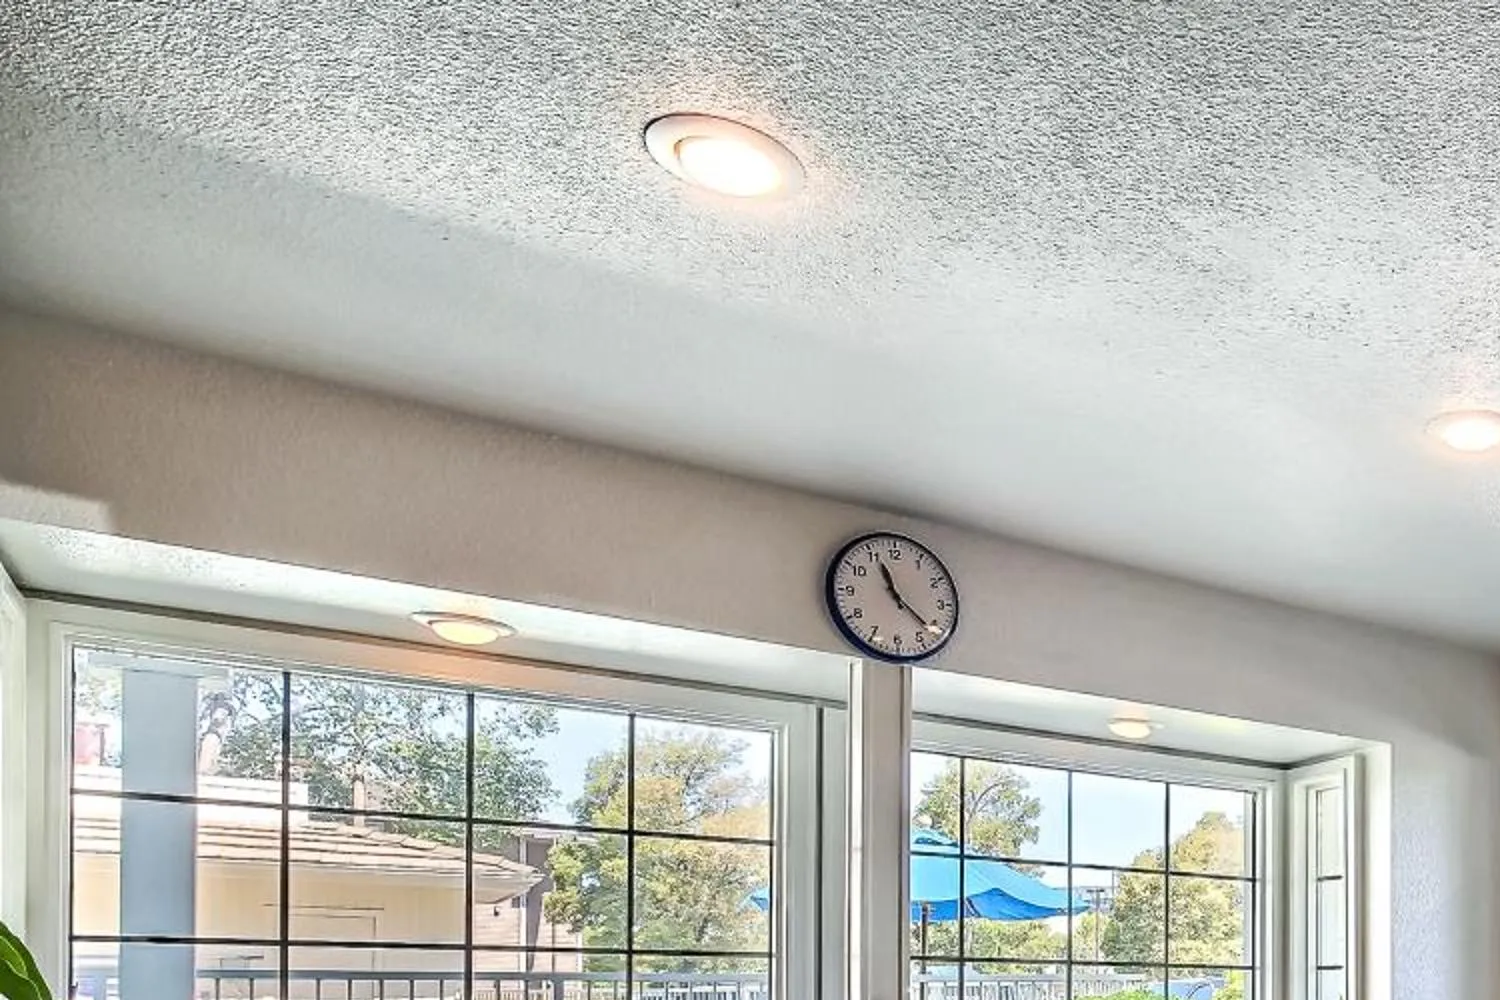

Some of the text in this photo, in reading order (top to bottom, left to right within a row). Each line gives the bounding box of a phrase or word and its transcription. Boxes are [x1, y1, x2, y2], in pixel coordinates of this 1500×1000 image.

[868, 551, 879, 562] 11
[888, 549, 902, 561] 12
[852, 565, 866, 577] 10
[929, 578, 938, 589] 2
[845, 586, 855, 596] 9
[936, 599, 945, 611] 3
[853, 607, 863, 618] 8
[870, 625, 879, 636] 7
[893, 635, 902, 645] 6
[915, 632, 925, 643] 5
